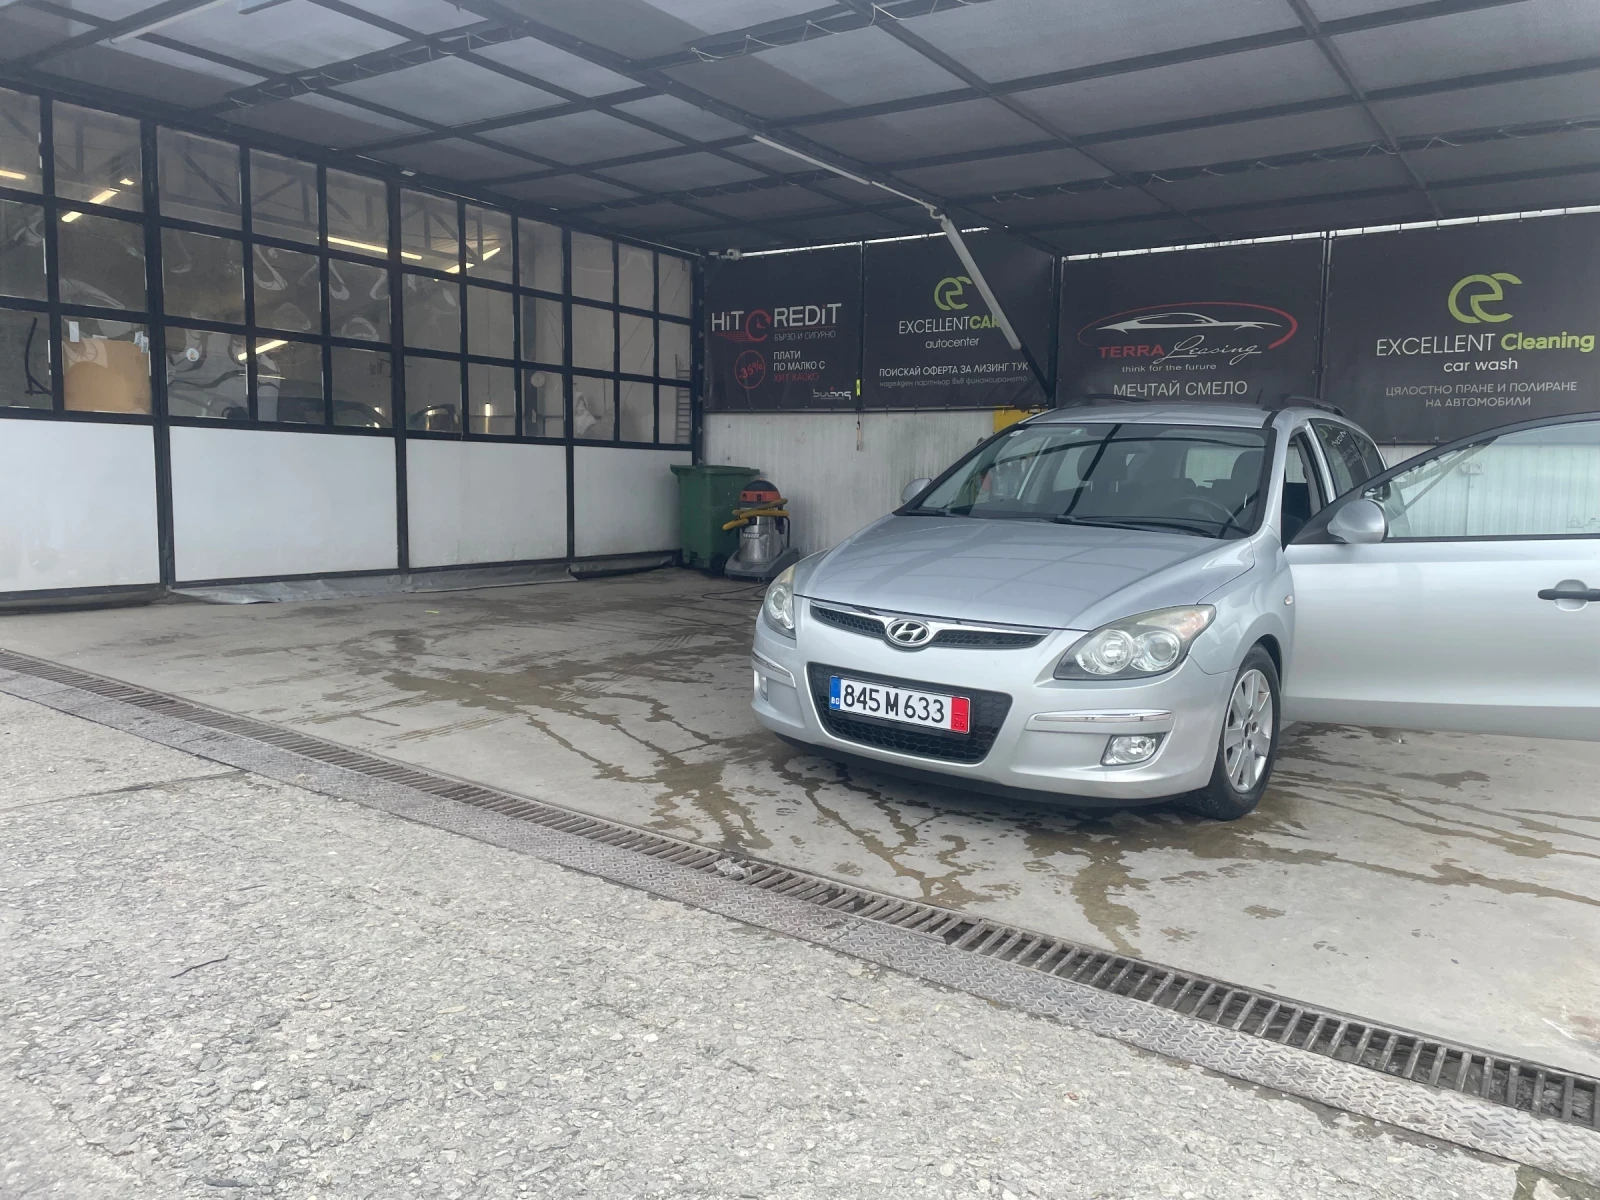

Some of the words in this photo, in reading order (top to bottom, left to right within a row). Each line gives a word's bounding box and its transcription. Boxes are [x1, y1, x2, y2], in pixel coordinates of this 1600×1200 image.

[774, 332, 796, 342] БЪРЗО
[798, 332, 804, 340] И
[804, 330, 836, 340] СИГУРНО
[925, 337, 980, 349] autocenter
[1376, 333, 1496, 356] EXCELLENT
[1500, 331, 1595, 353] Cleaning
[773, 350, 801, 360] ПЛАТИ
[1098, 344, 1165, 359] TERRA
[1153, 334, 1262, 366] Leasing
[773, 362, 786, 372] ПО
[787, 361, 818, 371] МАЛКО
[879, 365, 921, 377] ПОИСКАЙ
[922, 365, 958, 376] ОФЕРТА
[960, 364, 972, 373] ЗА
[974, 362, 1009, 373] ЛИЗИНГ
[1011, 362, 1029, 371] ТУК
[1122, 365, 1146, 373] think
[1149, 364, 1164, 372] for
[1443, 361, 1470, 373] car
[1475, 358, 1518, 371] wash
[1113, 380, 1180, 397] МЕЧТАЙ
[1185, 380, 1248, 396] СМЕЛО
[1386, 384, 1453, 397] ЦЯЛОСТНО
[1455, 383, 1494, 394] ПРАНЕ
[1497, 383, 1506, 393] И
[1510, 381, 1577, 393] ПОЛИРАНЕ
[1425, 398, 1442, 408] НА
[1445, 396, 1531, 408] АВТОМОБИЛИ
